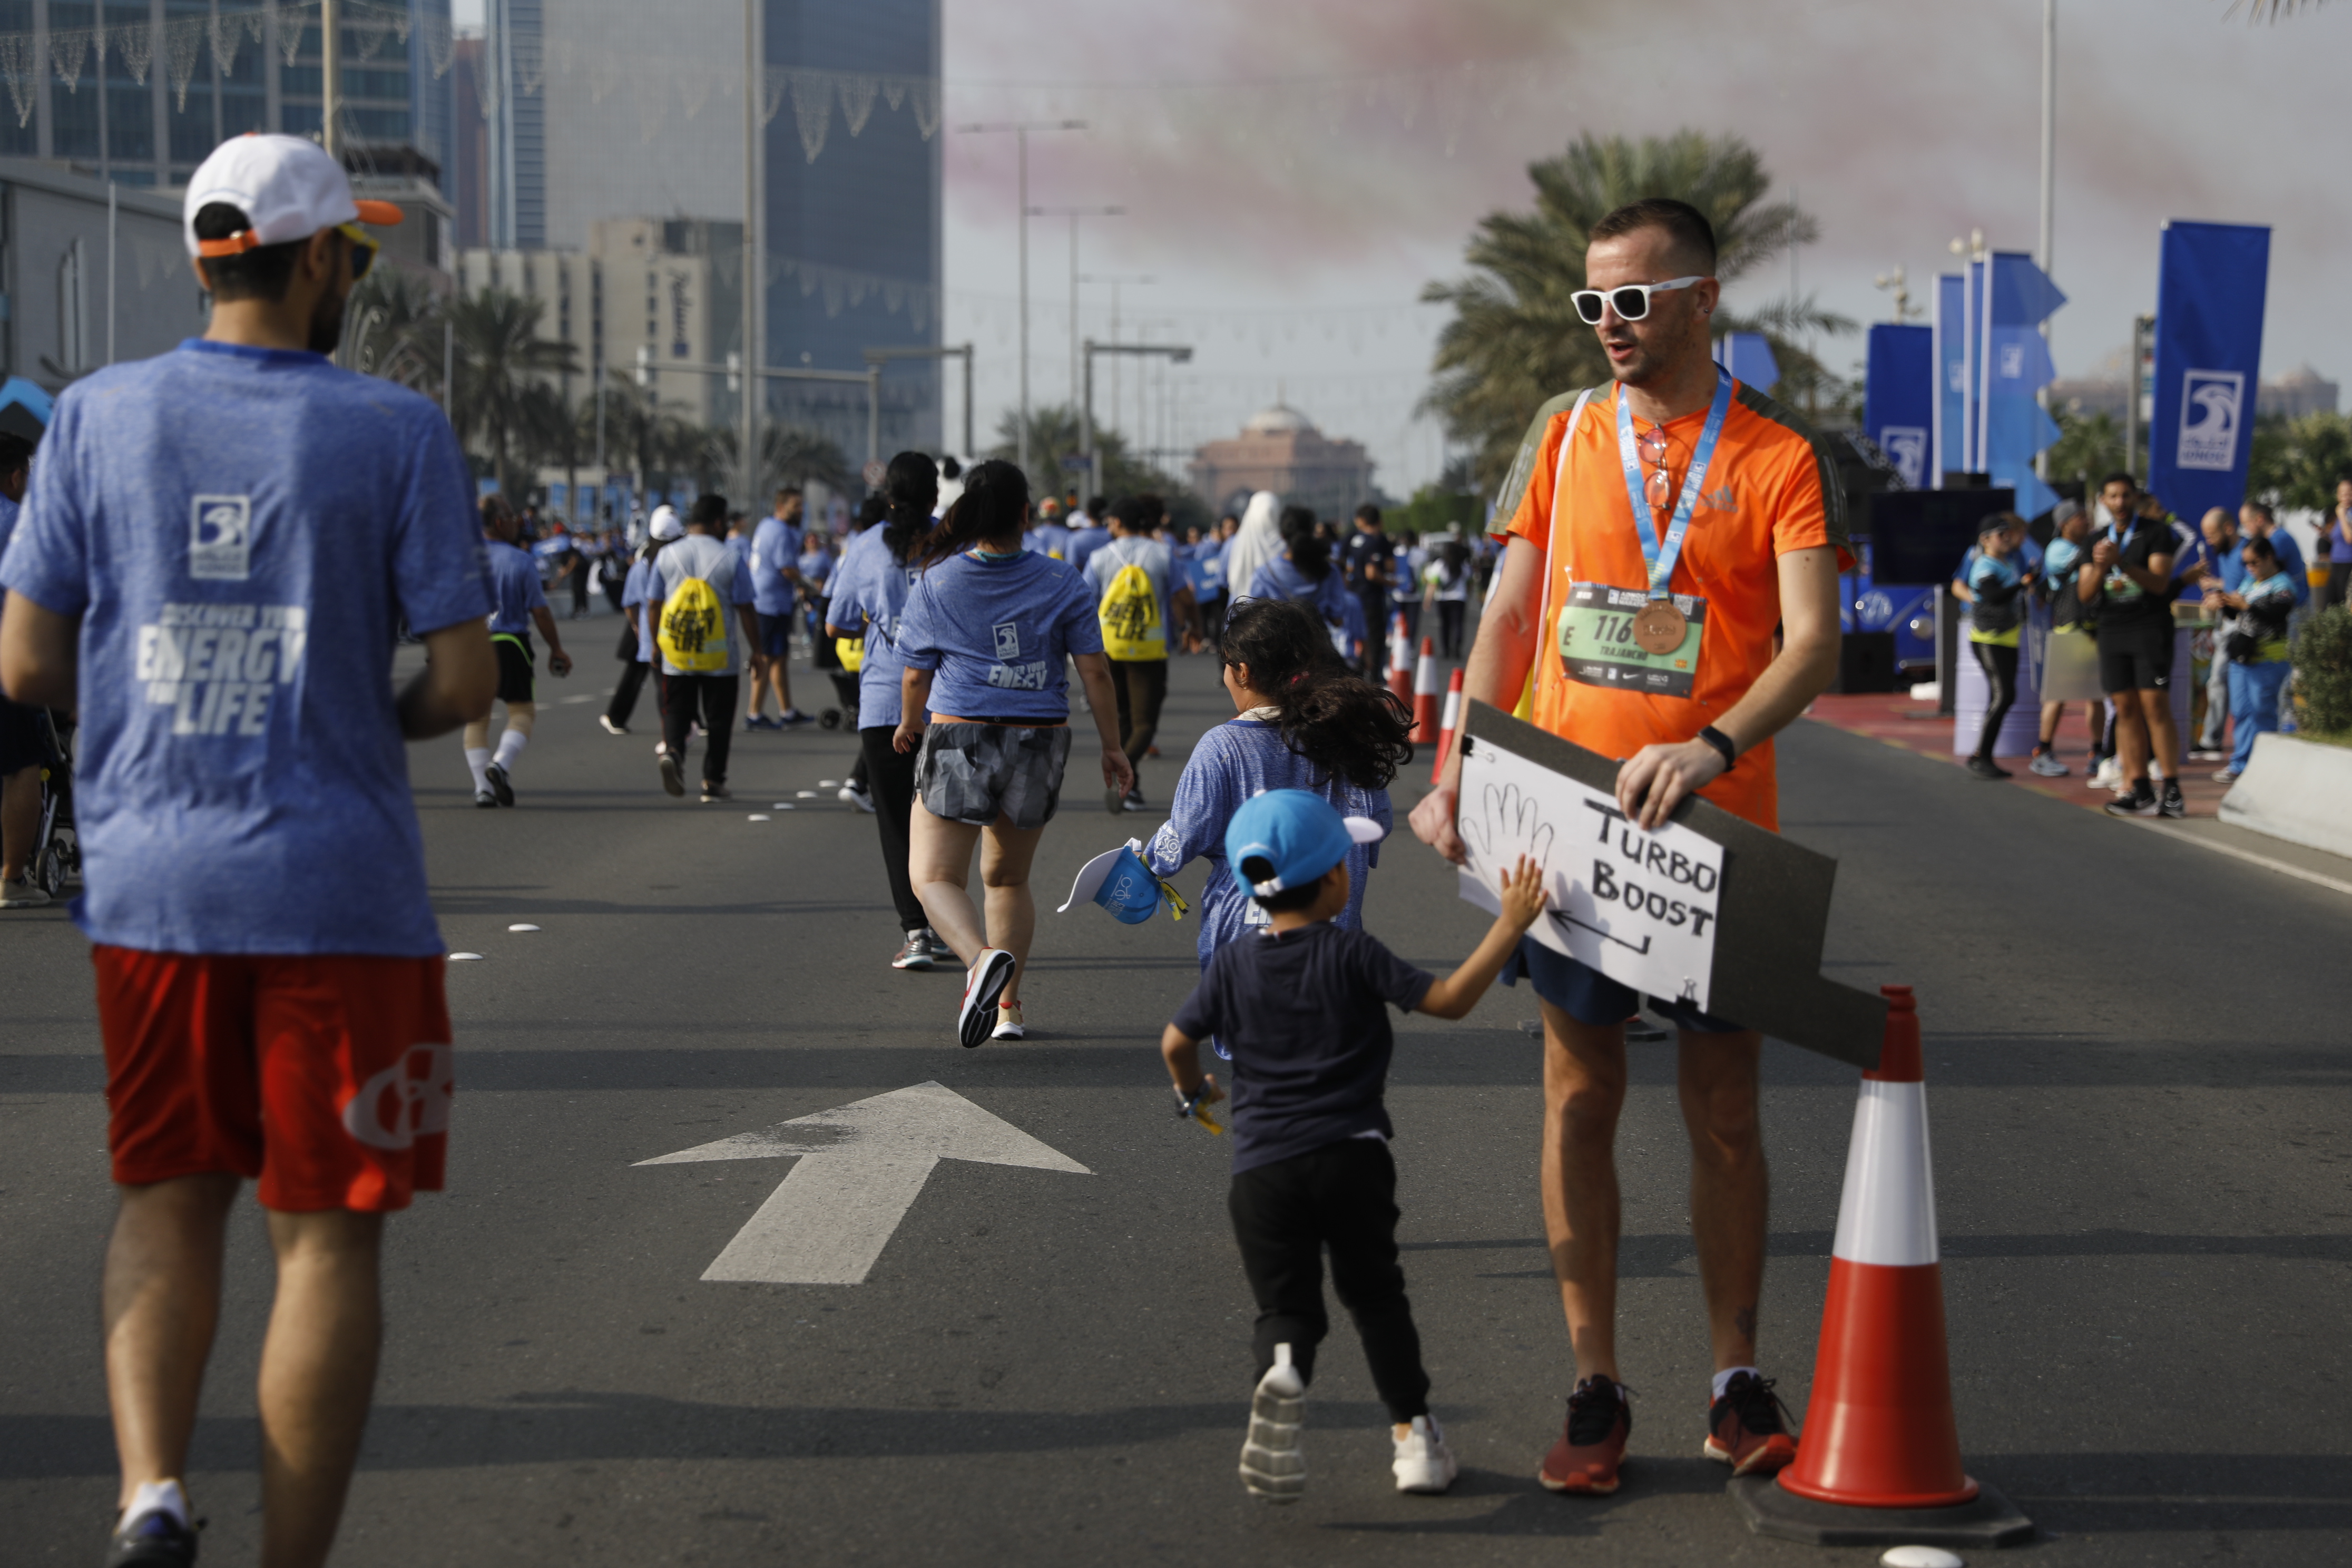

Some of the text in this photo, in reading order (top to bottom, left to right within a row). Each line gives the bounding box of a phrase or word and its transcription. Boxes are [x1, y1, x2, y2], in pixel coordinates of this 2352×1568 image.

[136, 624, 307, 684] ENERGY
[1563, 626, 1575, 645] E
[1593, 615, 1638, 644] 116
[172, 683, 274, 735] LIFE
[1583, 797, 1717, 893] TURBO
[1593, 858, 1714, 937] BOOST
